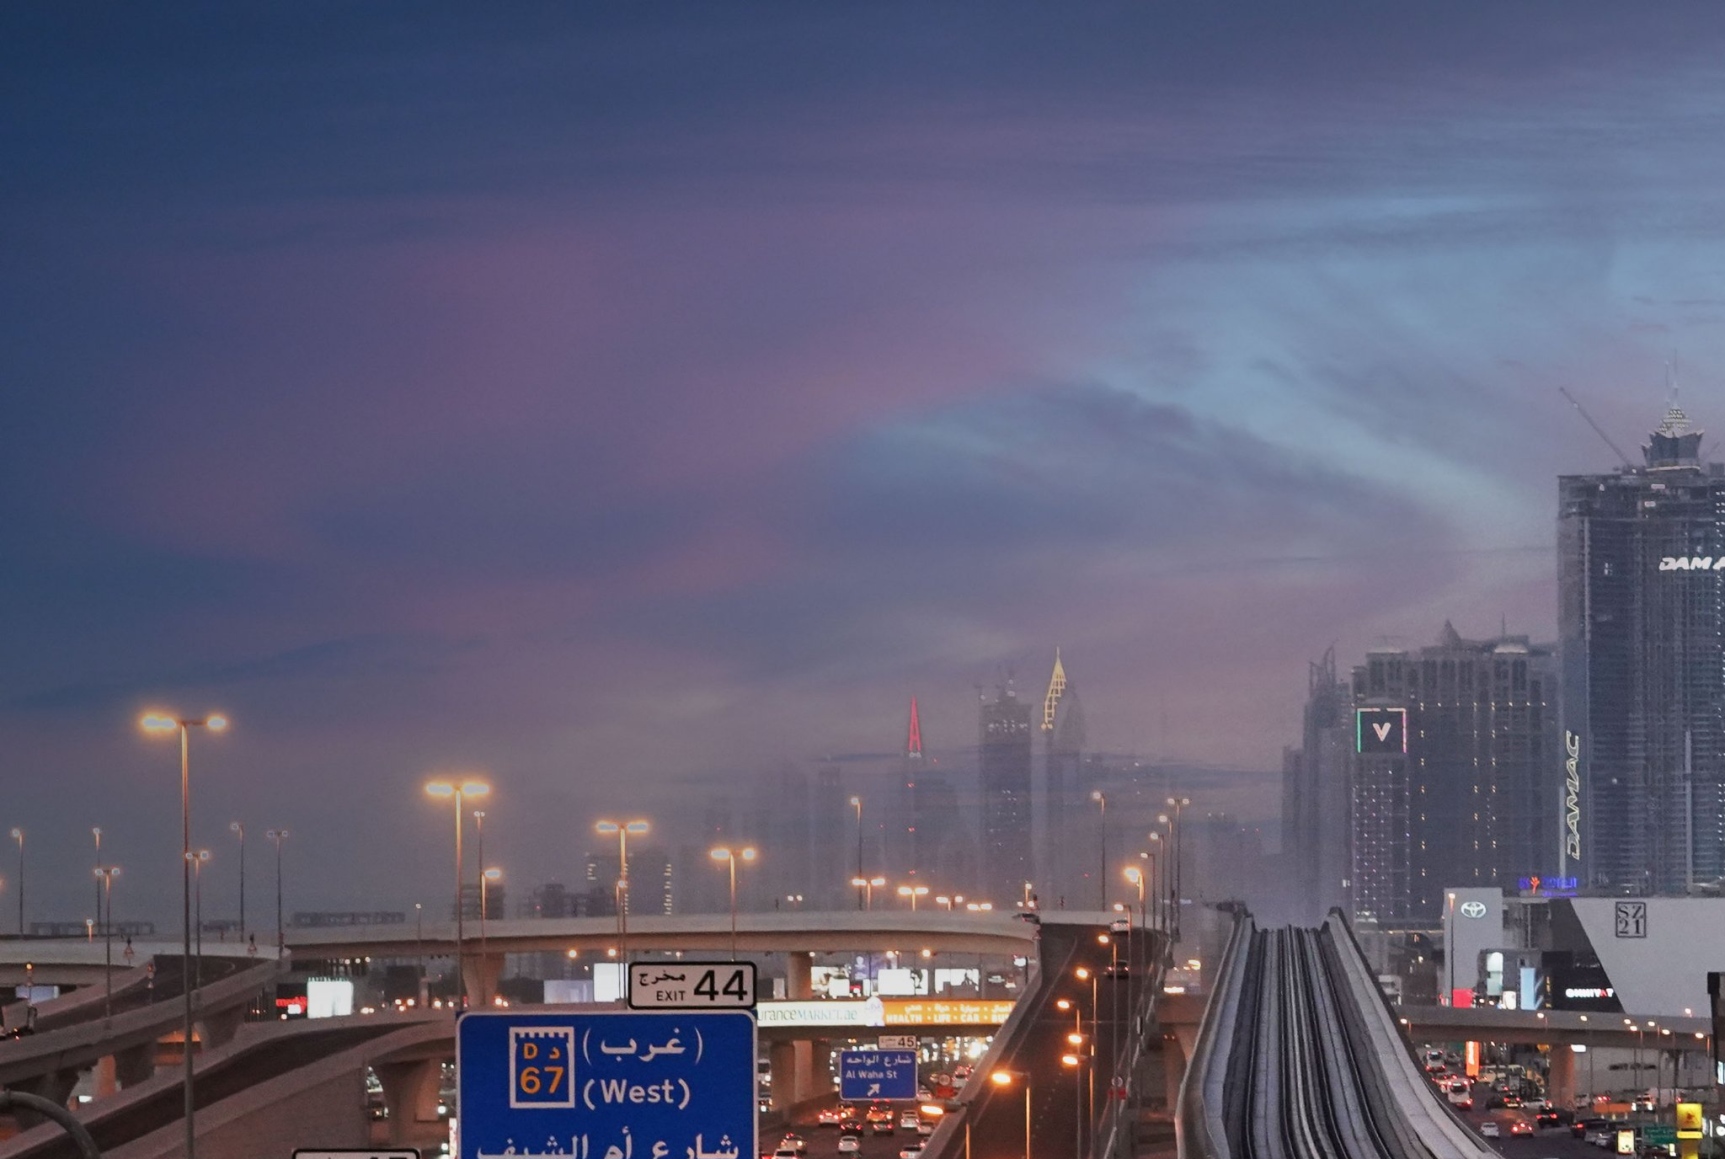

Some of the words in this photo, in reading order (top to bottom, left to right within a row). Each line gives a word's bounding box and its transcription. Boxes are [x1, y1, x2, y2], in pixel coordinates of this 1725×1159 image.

[1566, 729, 1580, 861] DAMAC
[638, 969, 686, 986] مخرج
[693, 969, 748, 1001] 44
[656, 990, 685, 1001] EXIT
[523, 1042, 538, 1060] D
[897, 1036, 915, 1048] 45
[519, 1066, 564, 1094] 67
[845, 1070, 856, 1079] Al
[858, 1069, 884, 1079] Waha
[886, 1070, 898, 1079] St
[582, 1077, 691, 1111] (West)
